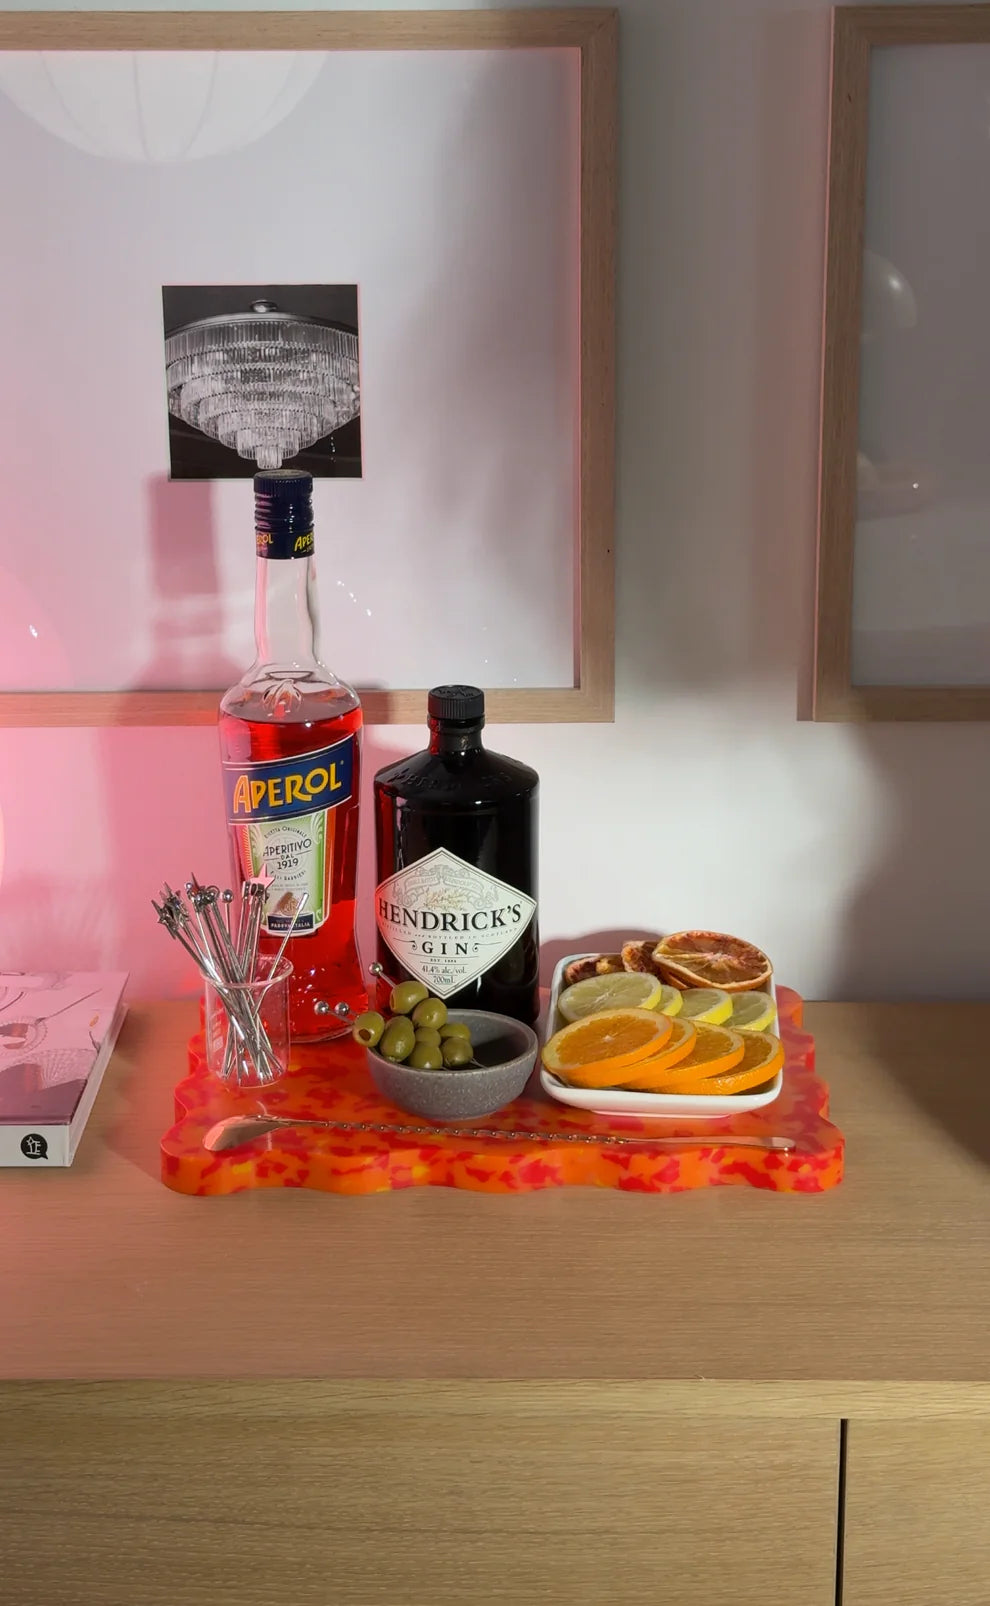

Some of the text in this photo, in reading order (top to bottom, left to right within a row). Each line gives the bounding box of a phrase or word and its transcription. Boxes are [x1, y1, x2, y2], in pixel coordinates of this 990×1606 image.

[233, 762, 342, 814] APEROL
[262, 838, 312, 857] APERITIVO
[277, 857, 299, 870] 1919
[280, 853, 295, 861] DAL
[378, 899, 521, 932] HENDRICK'S
[421, 940, 469, 955] GIN
[421, 964, 440, 973] 41.4%
